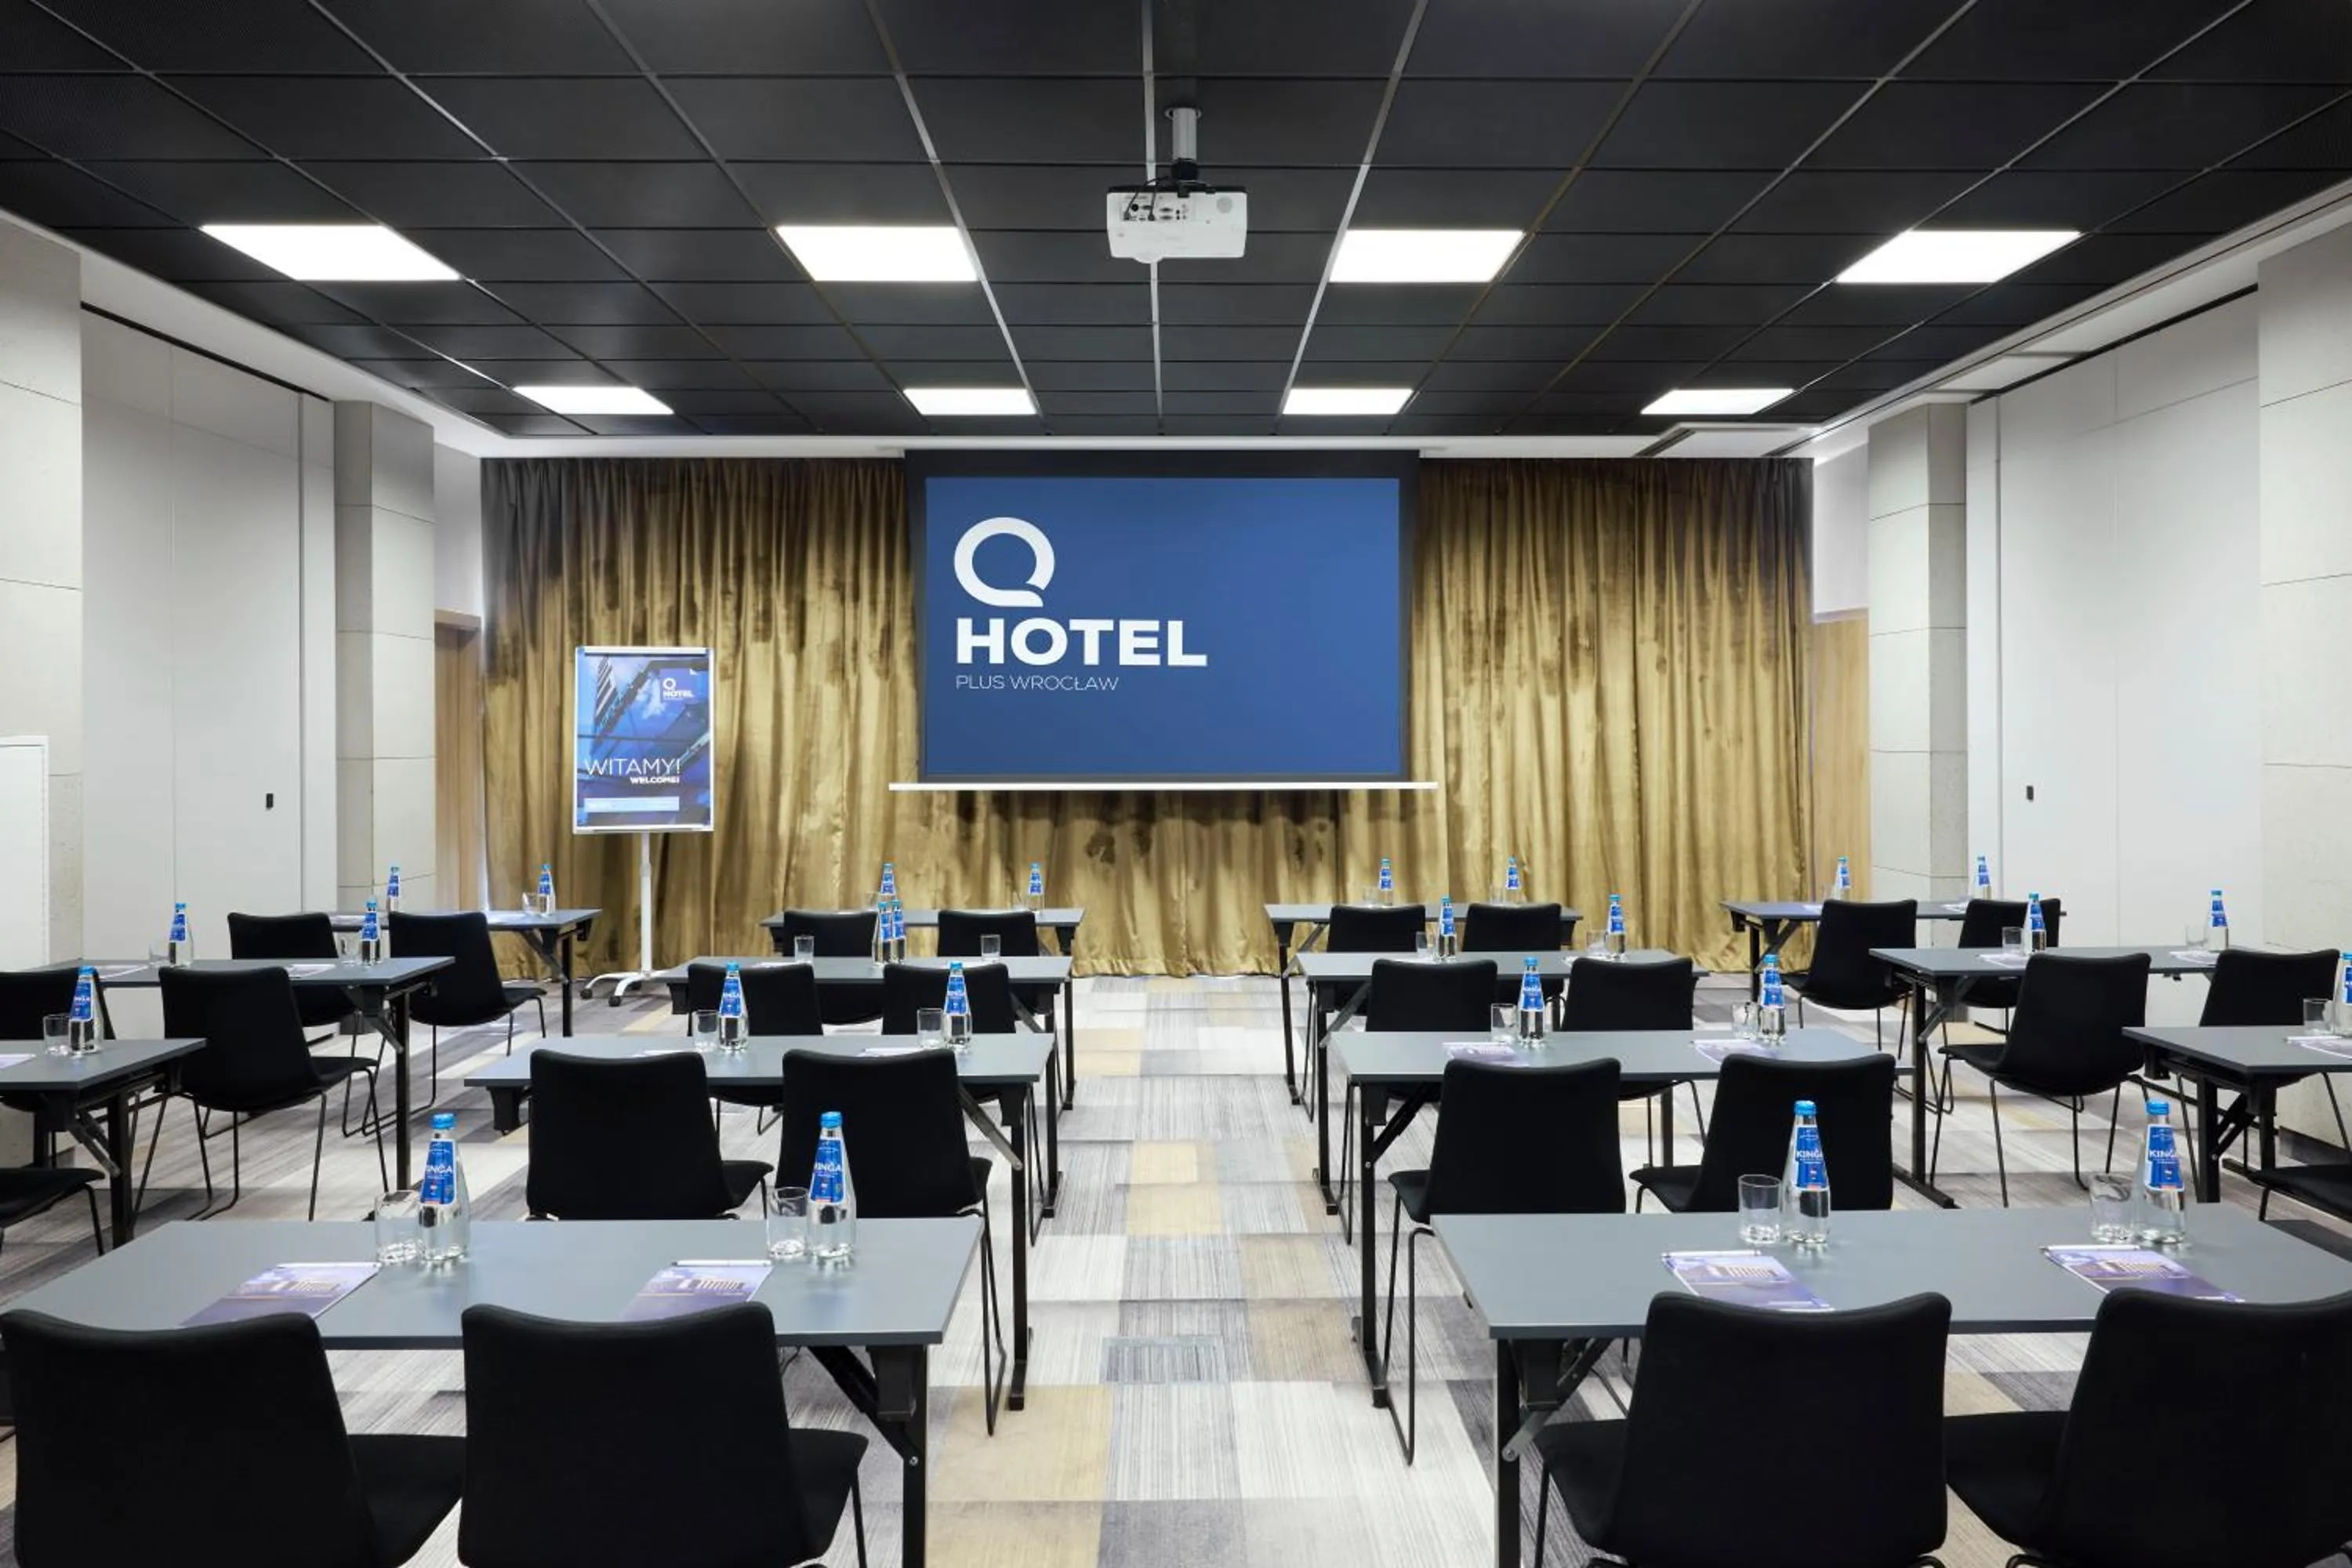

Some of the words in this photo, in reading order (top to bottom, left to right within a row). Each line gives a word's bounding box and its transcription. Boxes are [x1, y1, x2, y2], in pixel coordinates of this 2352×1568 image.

[953, 516, 1055, 608] Q
[956, 618, 1207, 667] HOTEL
[956, 675, 1004, 691] PLUS
[1007, 675, 1120, 692] WROCŁAW
[585, 757, 680, 775] WITAMY!
